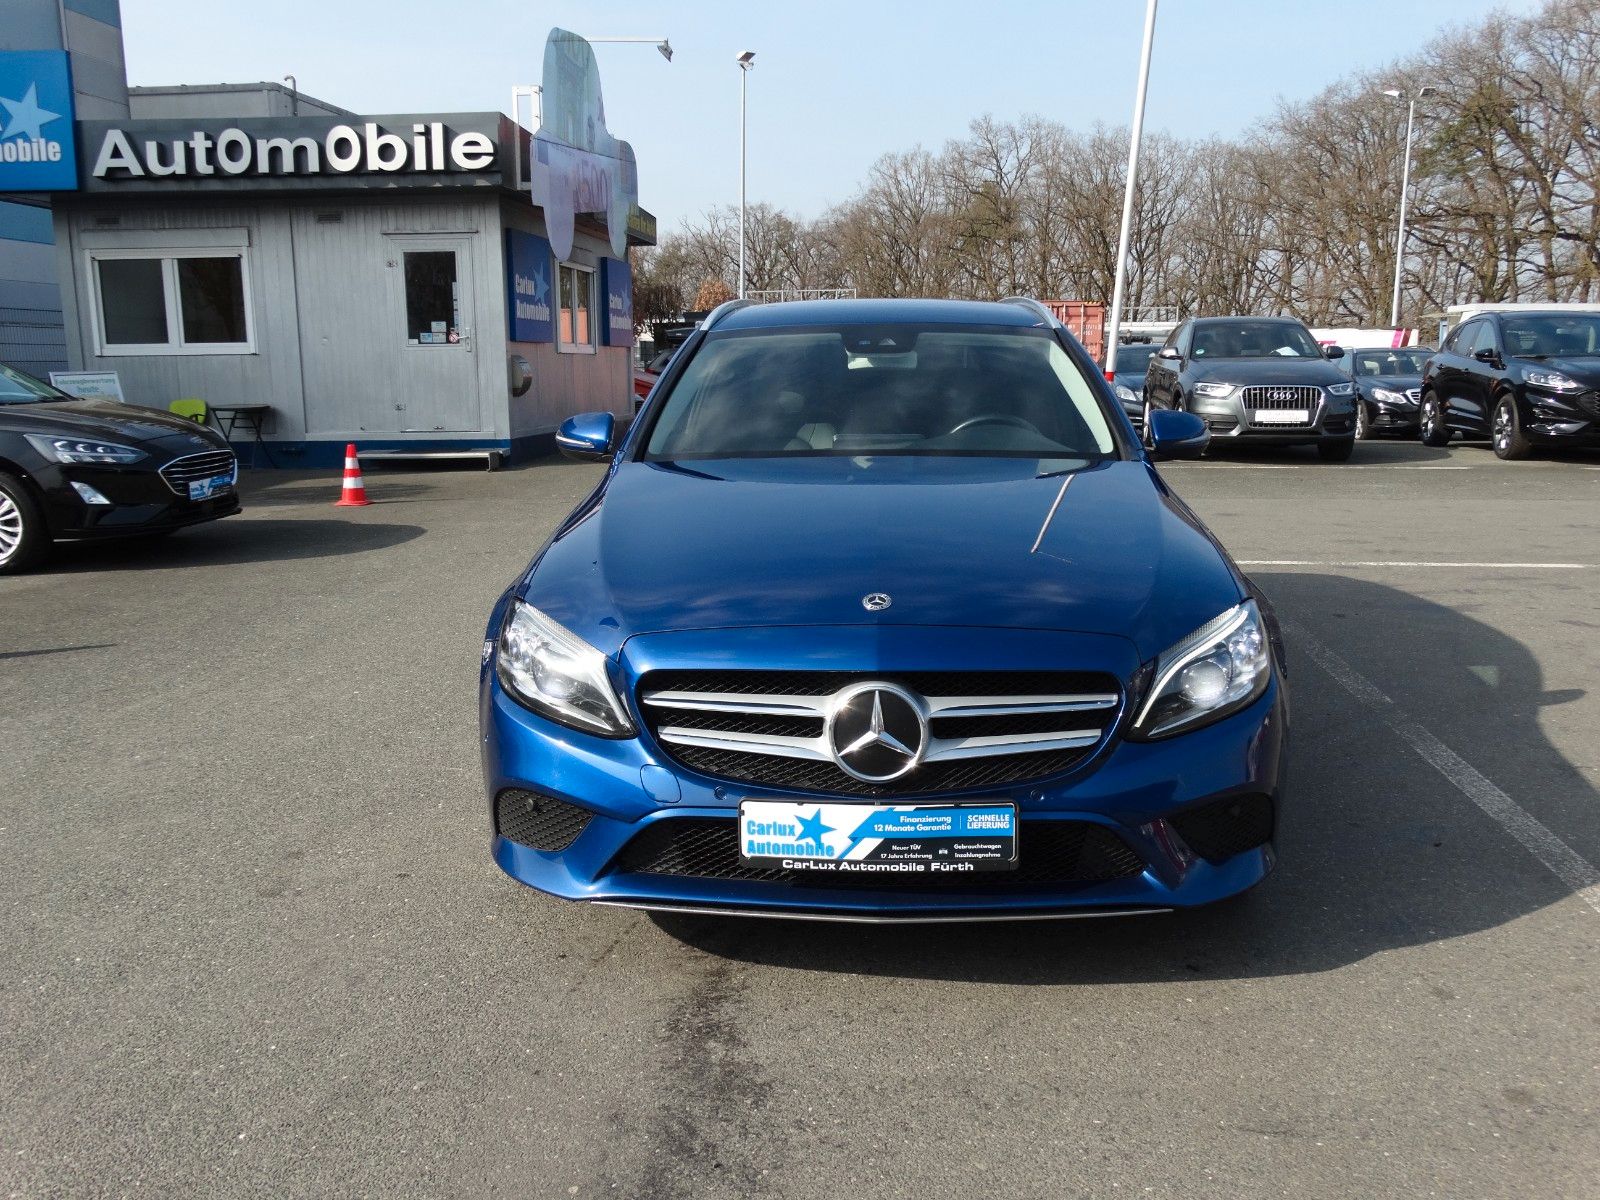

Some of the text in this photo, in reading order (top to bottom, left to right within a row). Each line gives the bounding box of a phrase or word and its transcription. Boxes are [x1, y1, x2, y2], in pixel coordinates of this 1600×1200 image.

[515, 273, 536, 296] Carlux
[516, 299, 550, 322] Automobile
[899, 815, 952, 825] Finanzierung
[966, 814, 1010, 822] SCHNELLE
[746, 820, 796, 837] Carlux
[873, 823, 952, 832] 12 Monate Garantie
[966, 821, 1010, 830] LIEFERUNG
[746, 839, 836, 857] Automobile
[910, 843, 922, 851] TÜV
[953, 843, 1002, 851] Gebrauchtwagen
[904, 853, 933, 861] Erfahrung
[954, 852, 1001, 860] Inzahlungnahme
[782, 859, 974, 873] CarLux Automobile Fürth
